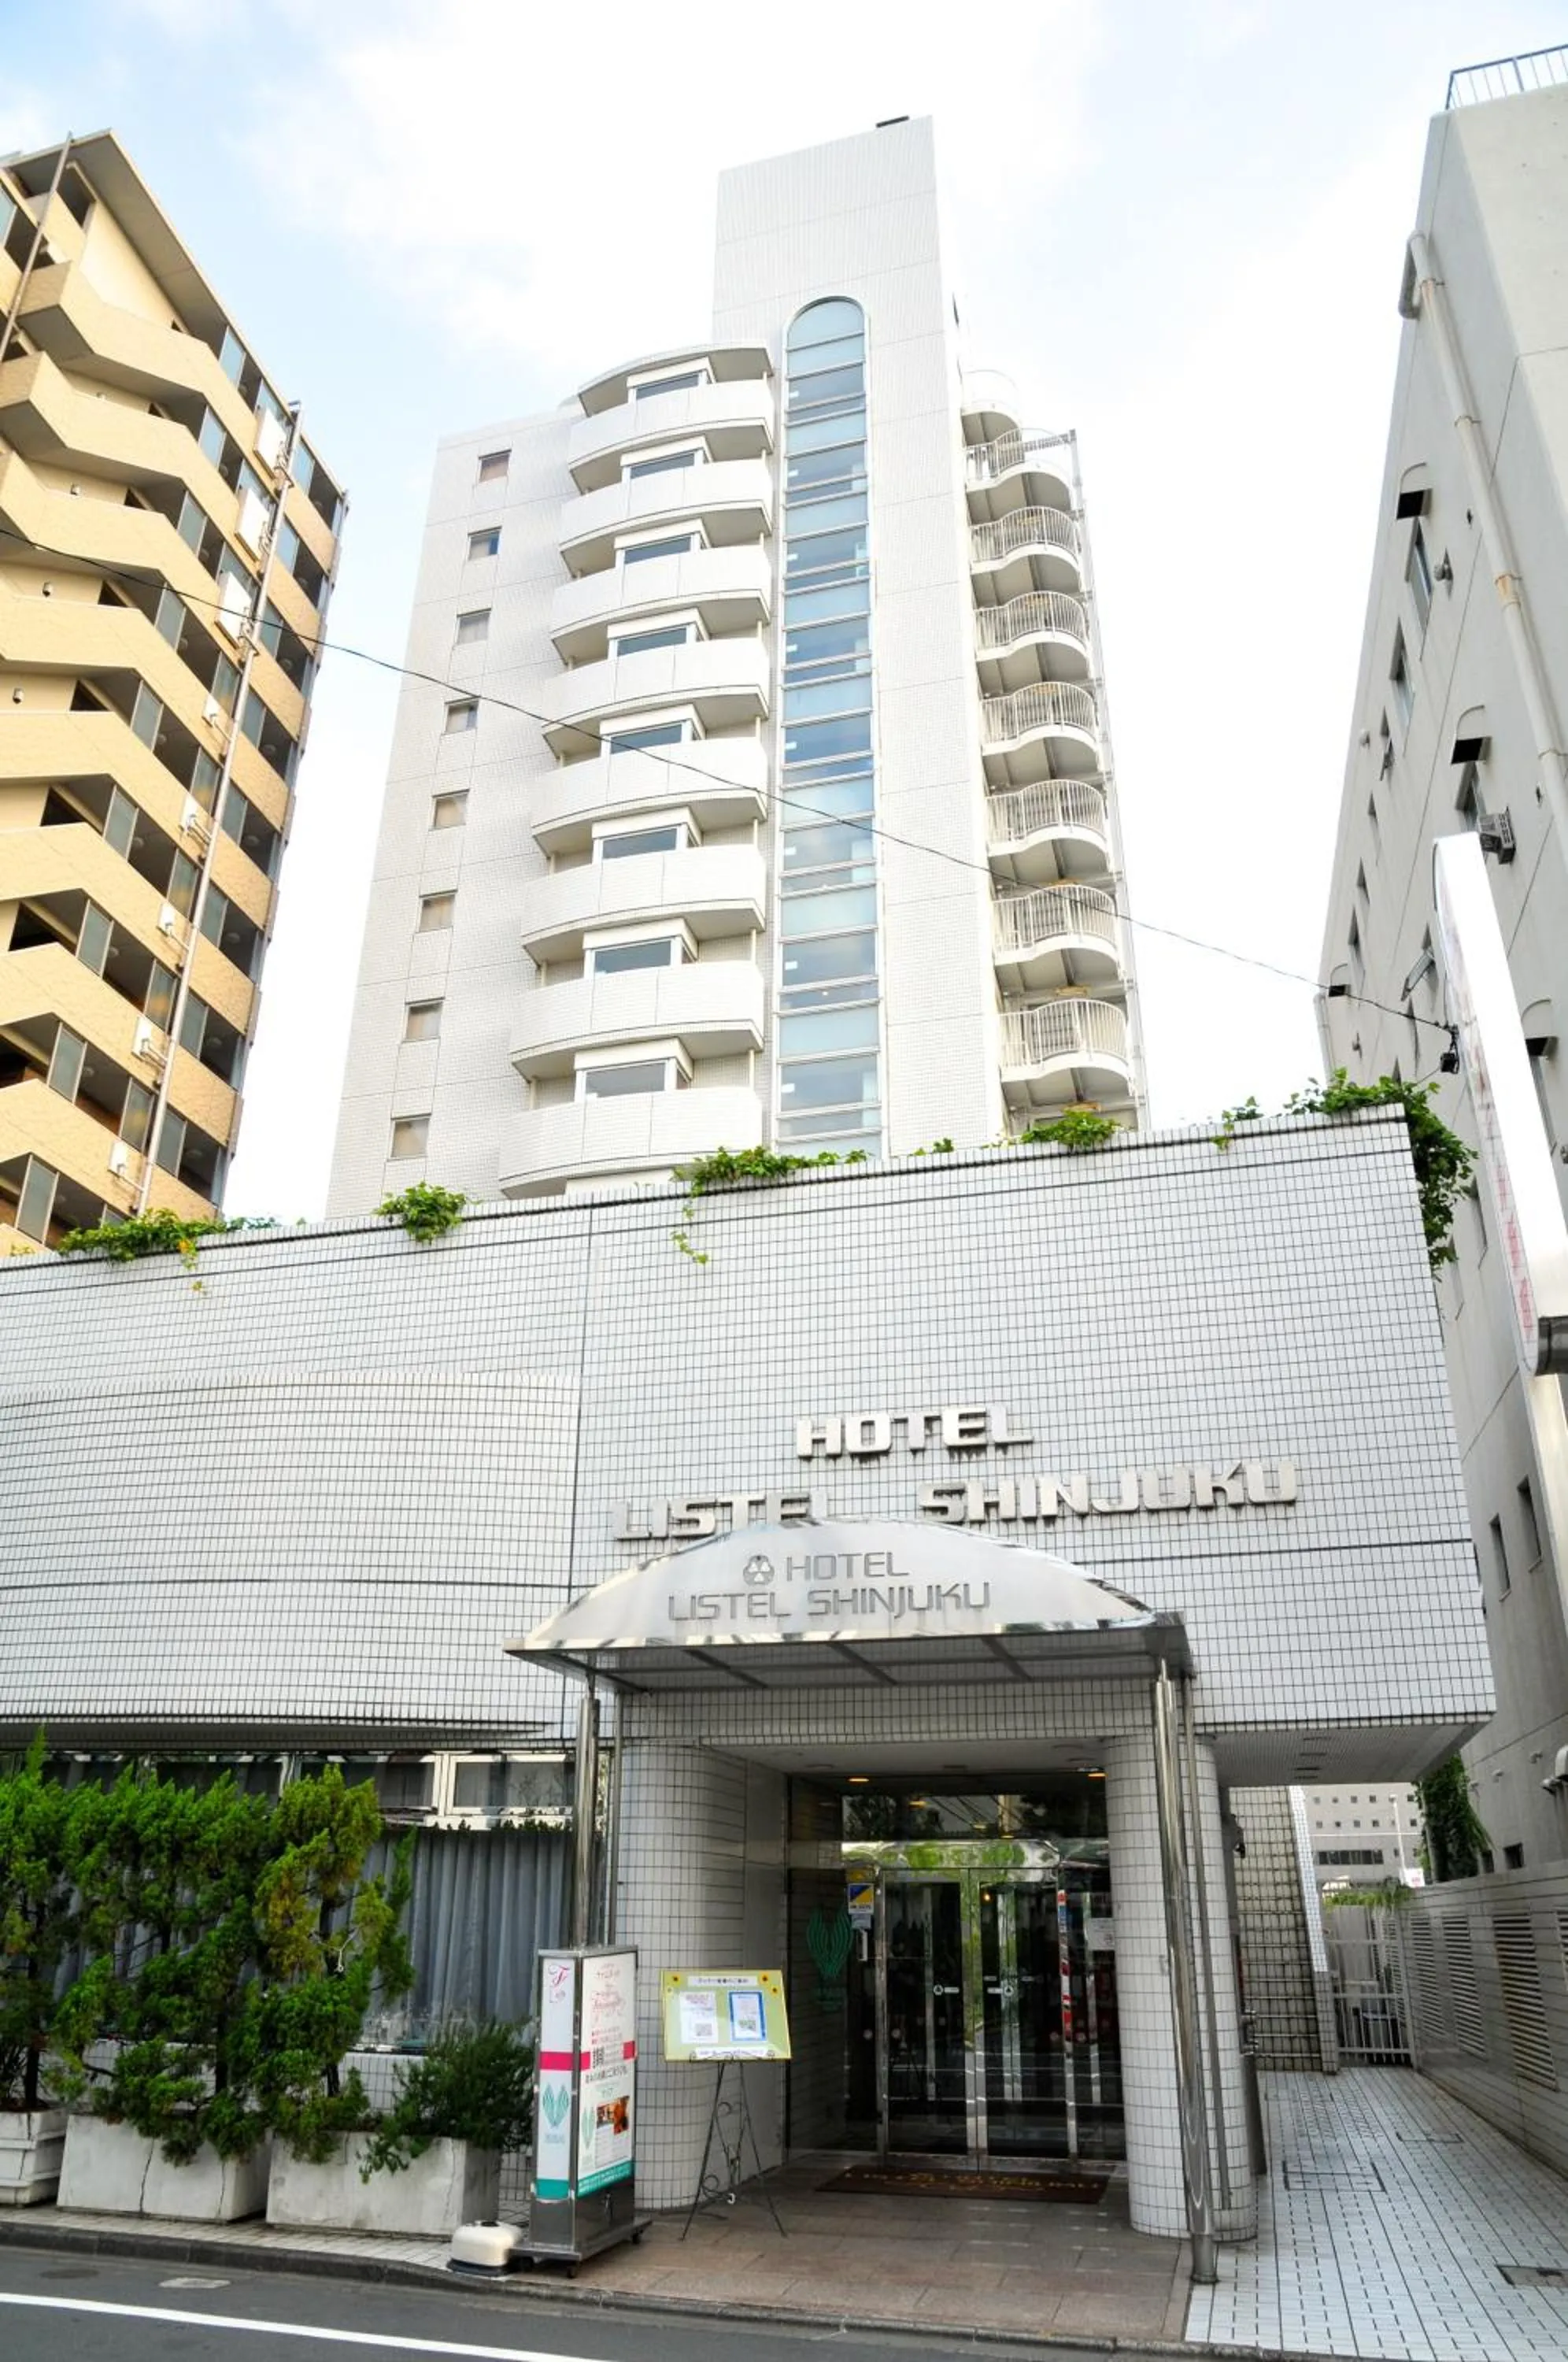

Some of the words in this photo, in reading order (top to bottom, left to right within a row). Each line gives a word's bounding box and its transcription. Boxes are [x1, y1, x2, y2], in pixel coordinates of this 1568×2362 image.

[796, 1403, 1034, 1458] HOTEL
[919, 1461, 1297, 1524] SHINJUKU
[786, 1551, 910, 1582] HOTEL
[668, 1591, 792, 1620] LISTEL
[807, 1582, 991, 1619] SHINJUKU
